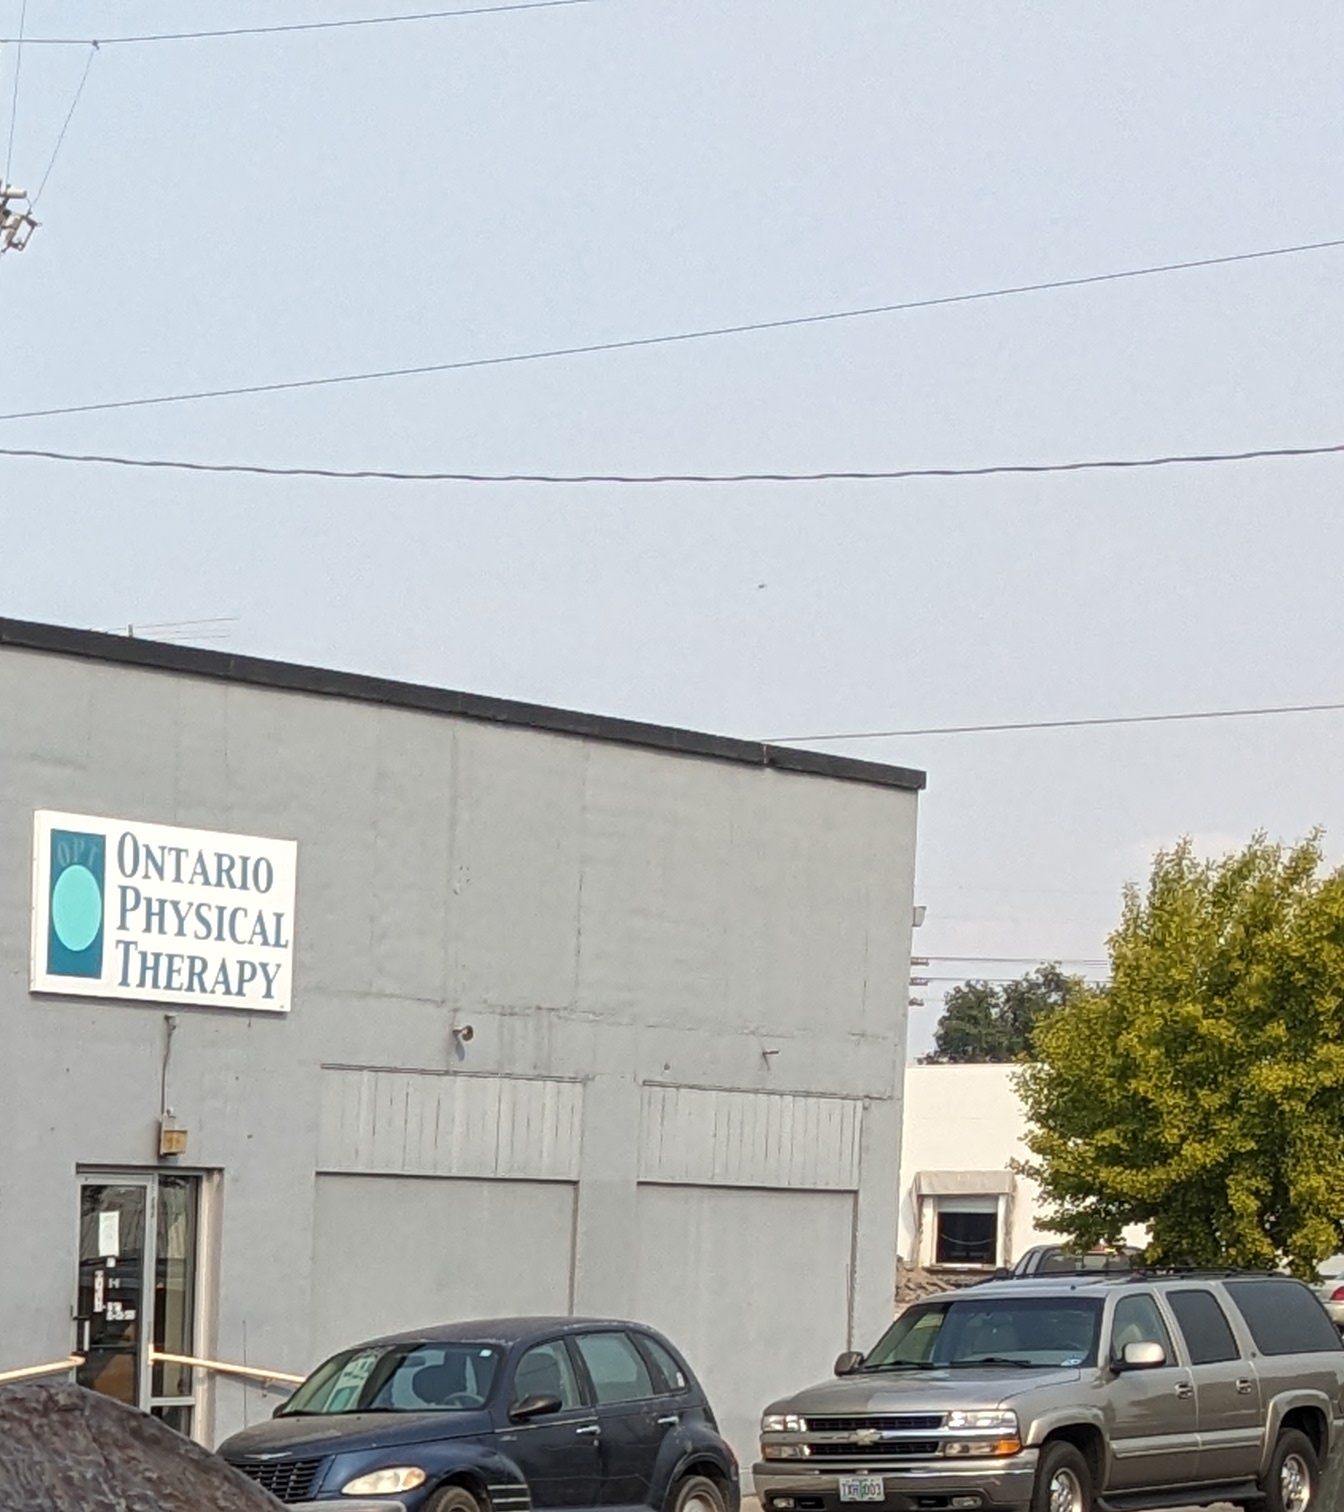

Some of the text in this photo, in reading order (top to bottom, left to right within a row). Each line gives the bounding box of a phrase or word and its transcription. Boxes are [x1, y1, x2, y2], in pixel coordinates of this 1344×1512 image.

[117, 831, 274, 894] ONTARIO
[116, 884, 289, 949] PHYSICAL
[115, 939, 282, 999] THERAPY
